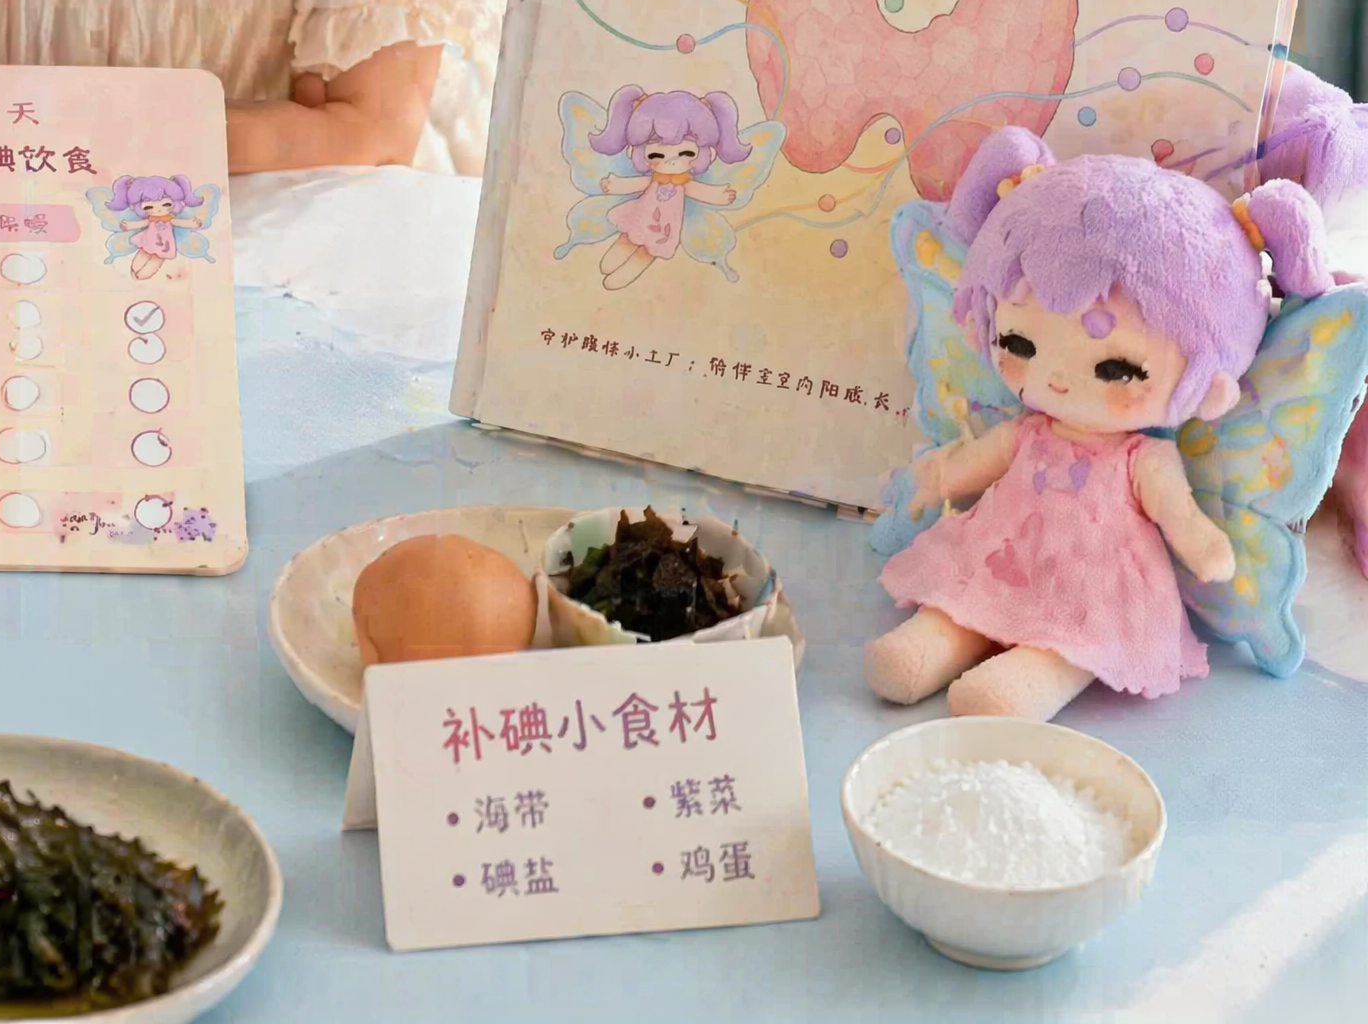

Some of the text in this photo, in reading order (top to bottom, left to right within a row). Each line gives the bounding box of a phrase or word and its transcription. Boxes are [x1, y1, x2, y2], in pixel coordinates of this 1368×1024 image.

[442, 687, 718, 764] 补碘小食材
[473, 789, 550, 833] 海带
[669, 774, 742, 819] 紫菜
[480, 856, 559, 898] 碘盐
[679, 840, 756, 883] 鸡蛋
